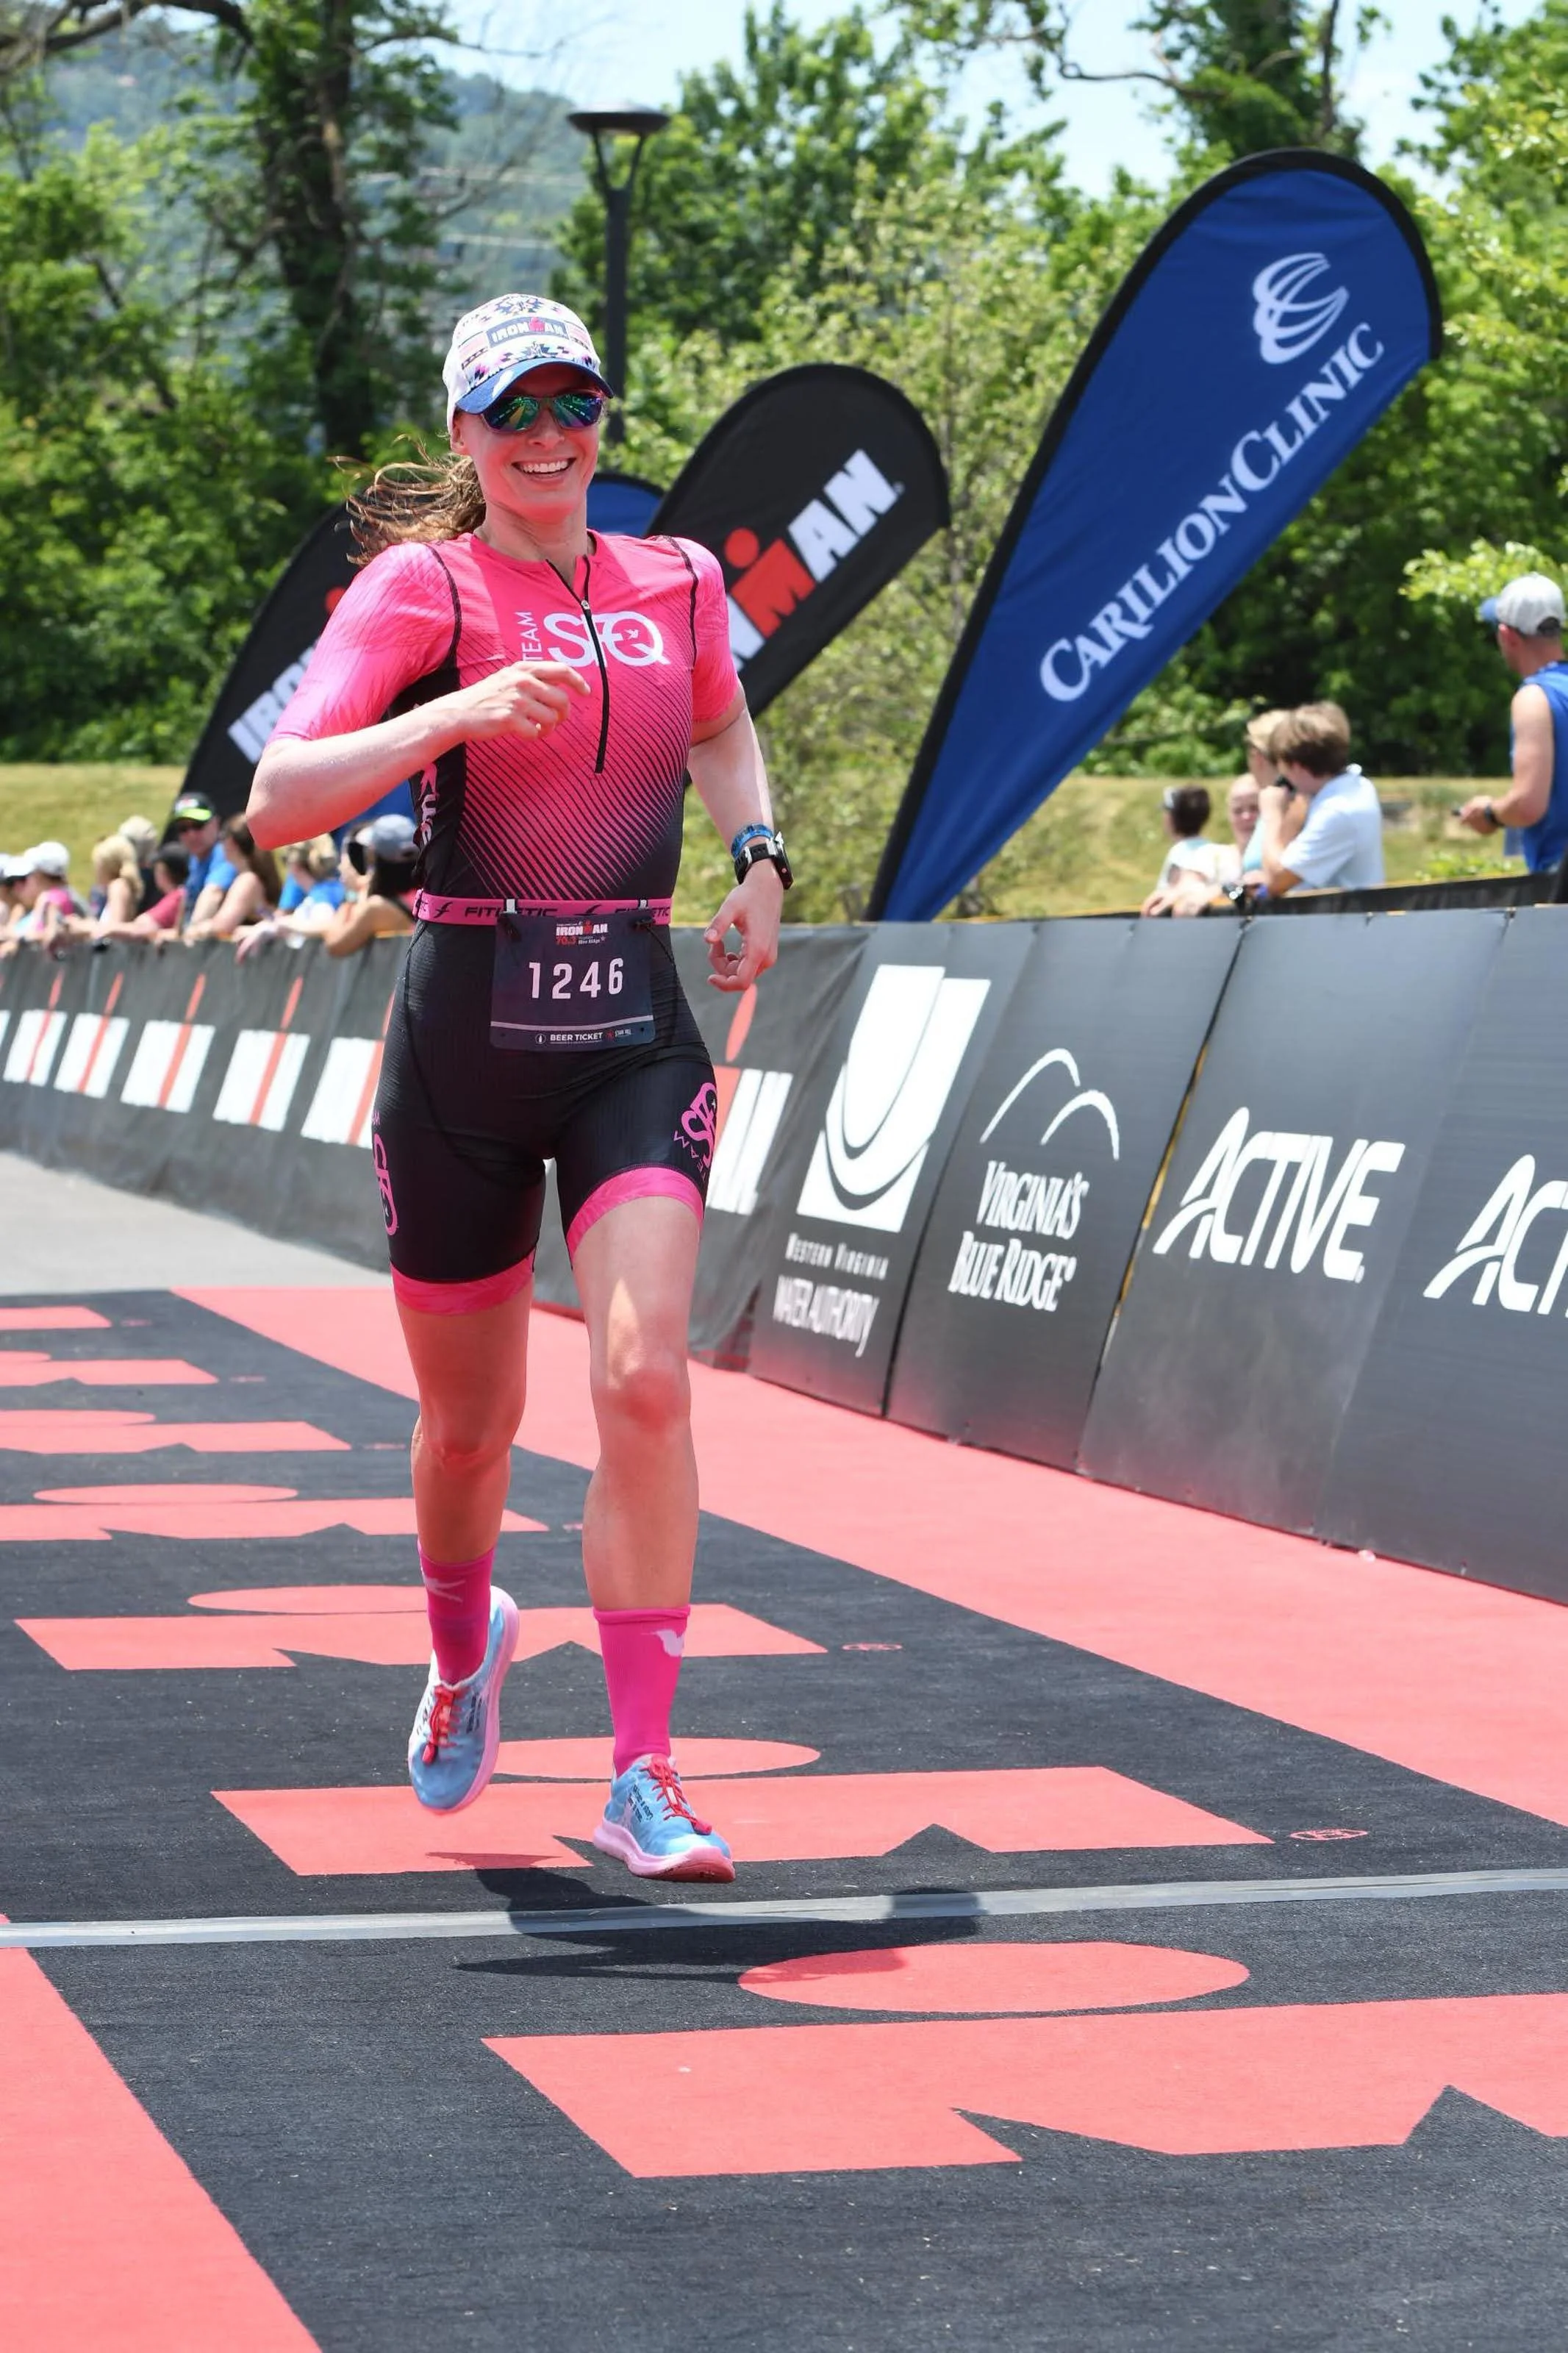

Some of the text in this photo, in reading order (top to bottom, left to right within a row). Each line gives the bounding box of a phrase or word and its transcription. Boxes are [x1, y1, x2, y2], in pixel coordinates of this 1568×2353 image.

[515, 612, 543, 661] TEAM
[529, 957, 623, 999] 1246
[575, 1032, 603, 1040] TICKET
[976, 1160, 1090, 1240] VIRGINIA'S
[1152, 1106, 1406, 1282] ACTIVE
[948, 1230, 1070, 1312] BLUE RIDGE
